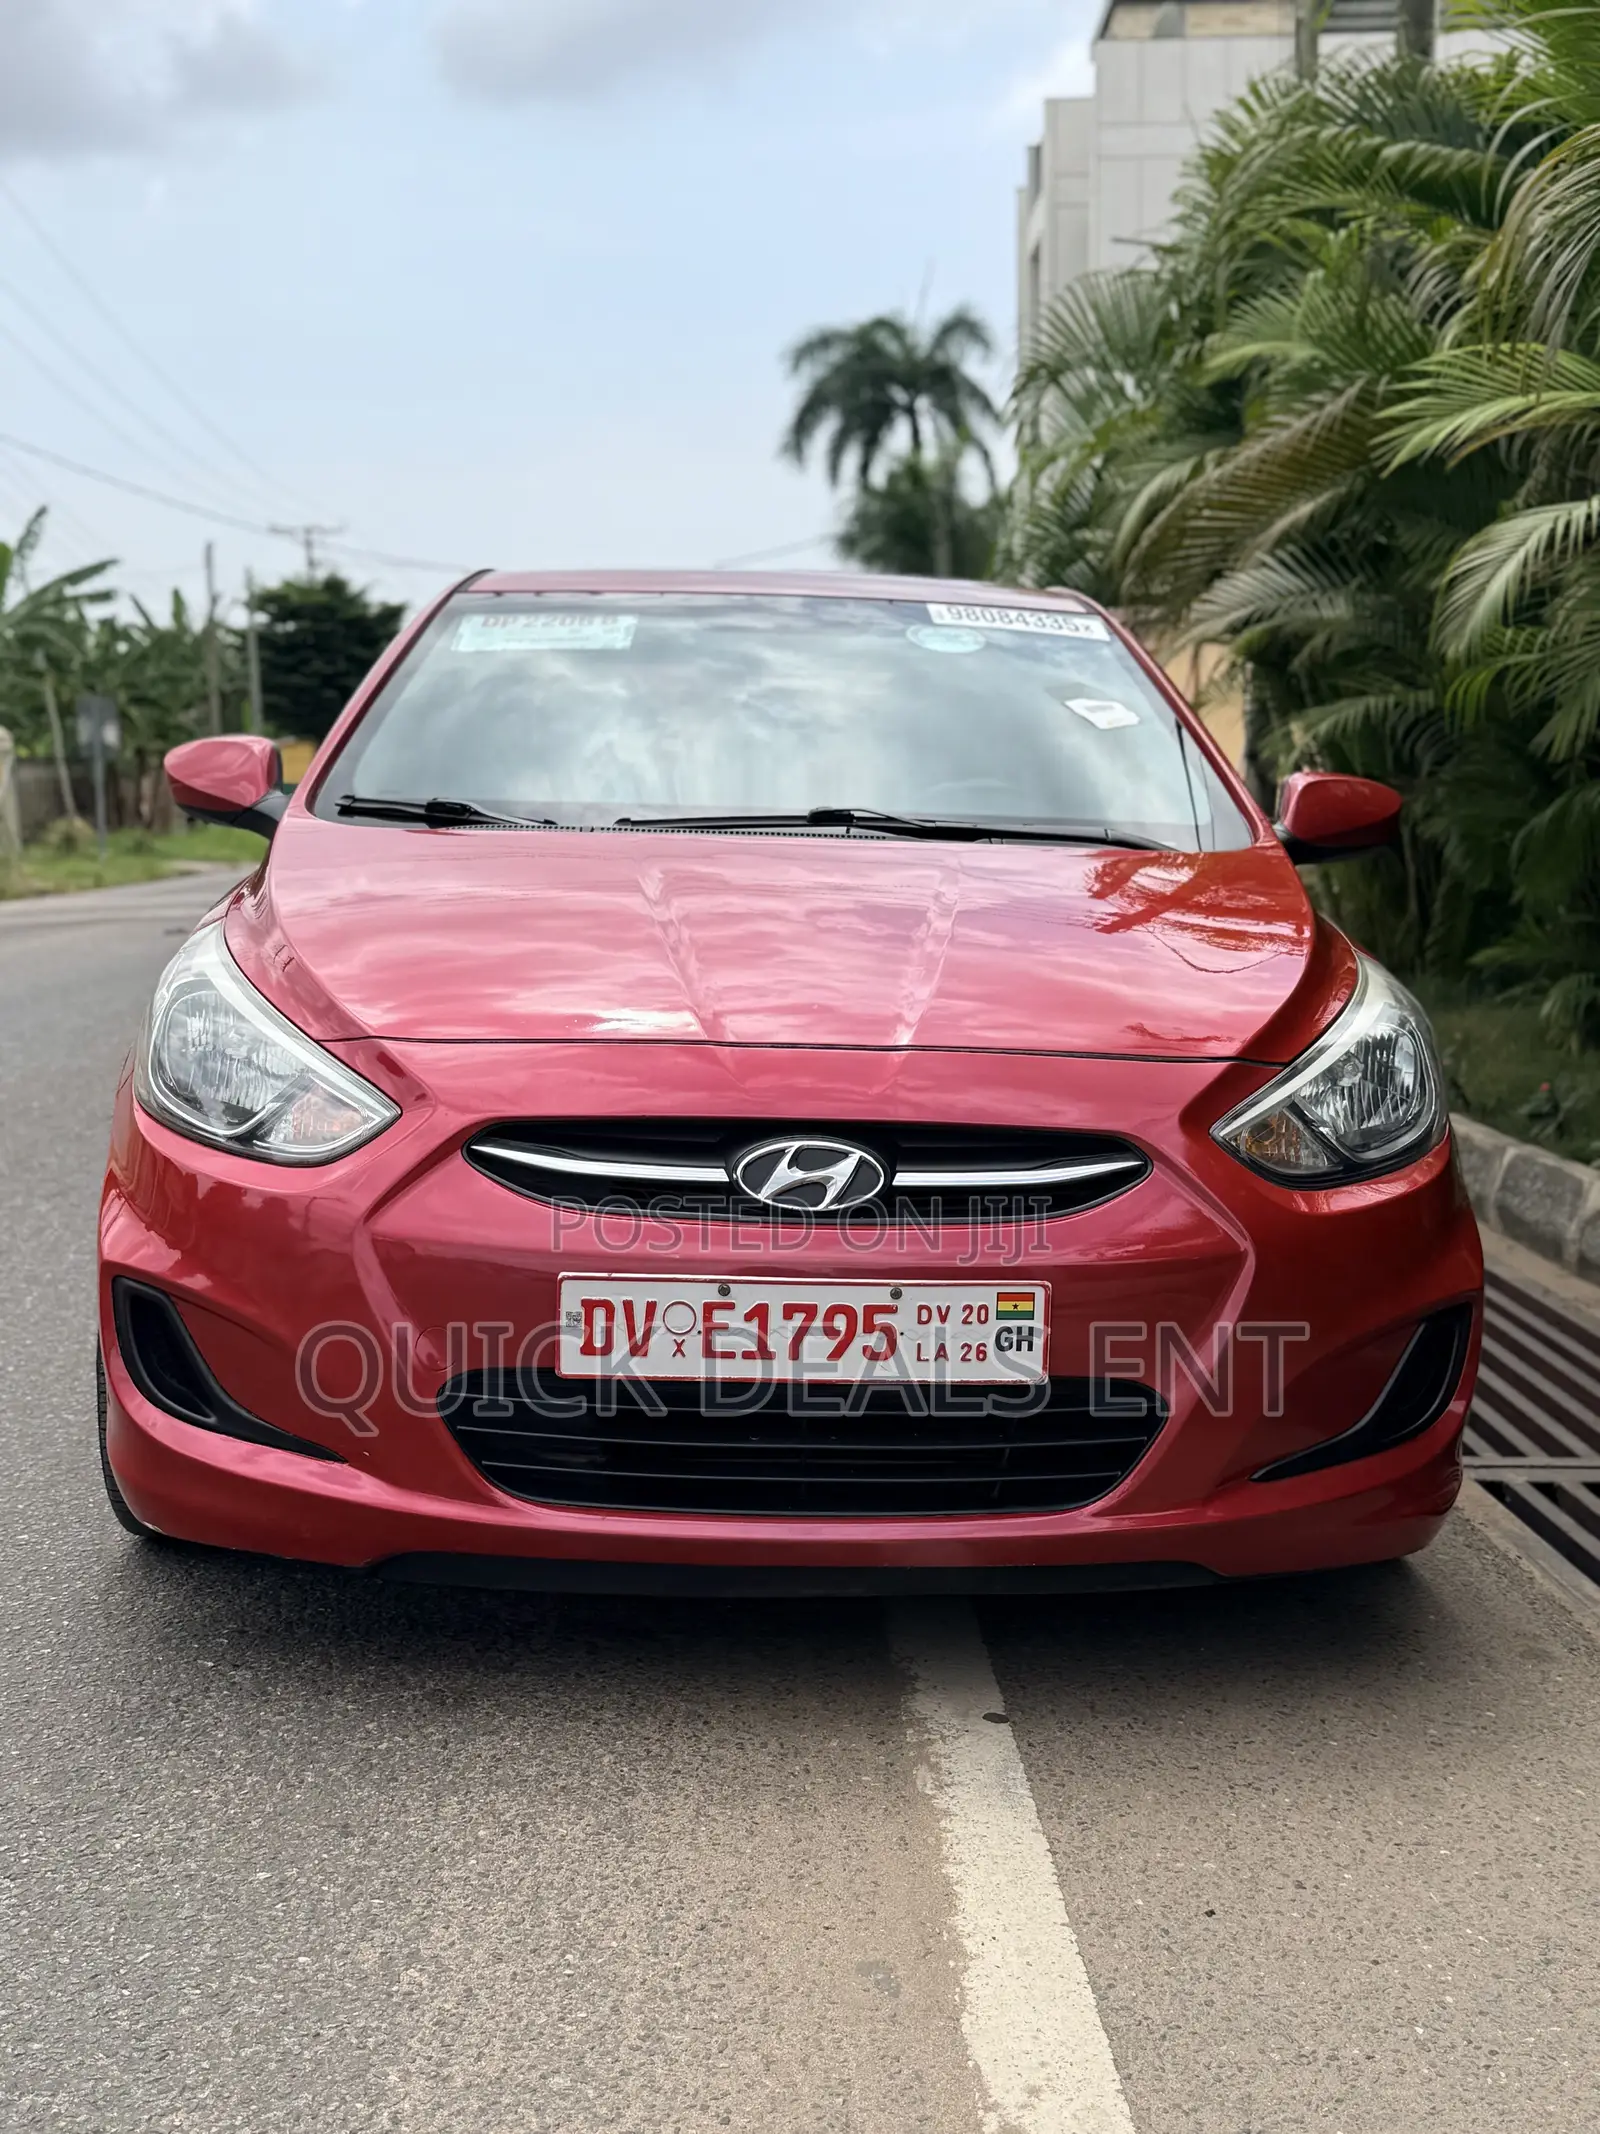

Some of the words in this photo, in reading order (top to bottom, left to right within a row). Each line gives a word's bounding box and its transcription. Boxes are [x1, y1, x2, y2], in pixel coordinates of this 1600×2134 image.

[917, 1304, 951, 1325] DV
[961, 1304, 989, 1325] 20
[580, 1298, 657, 1357] DV
[702, 1300, 898, 1362] E1795
[995, 1326, 1034, 1352] GH
[916, 1342, 949, 1362] LA
[960, 1342, 987, 1362] 26
